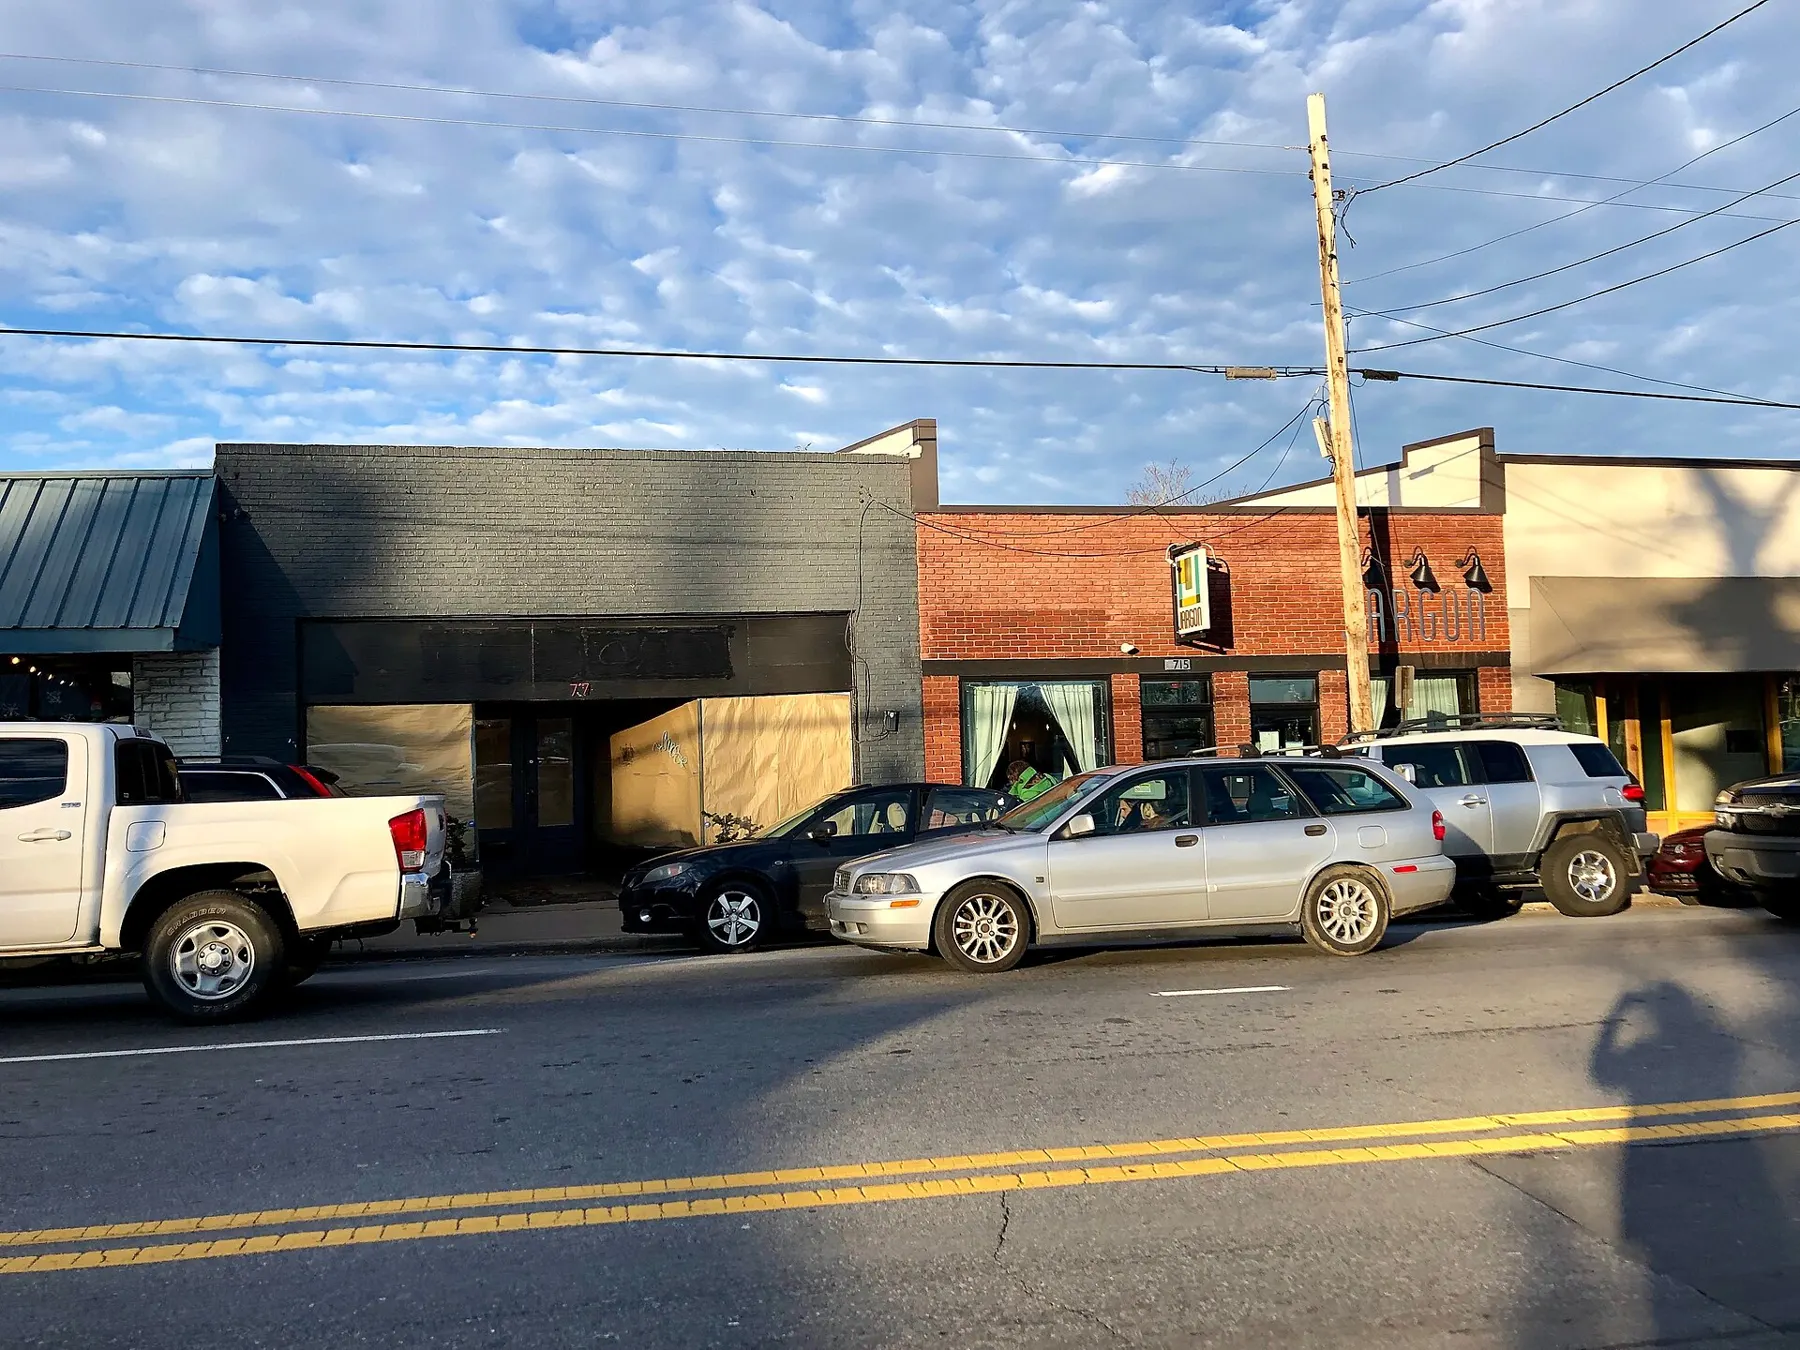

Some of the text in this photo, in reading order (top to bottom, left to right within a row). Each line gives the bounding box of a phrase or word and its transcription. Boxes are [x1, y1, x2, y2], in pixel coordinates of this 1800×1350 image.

[1180, 607, 1203, 630] ARGON
[1366, 587, 1486, 643] ARGON
[1173, 659, 1190, 670] 715
